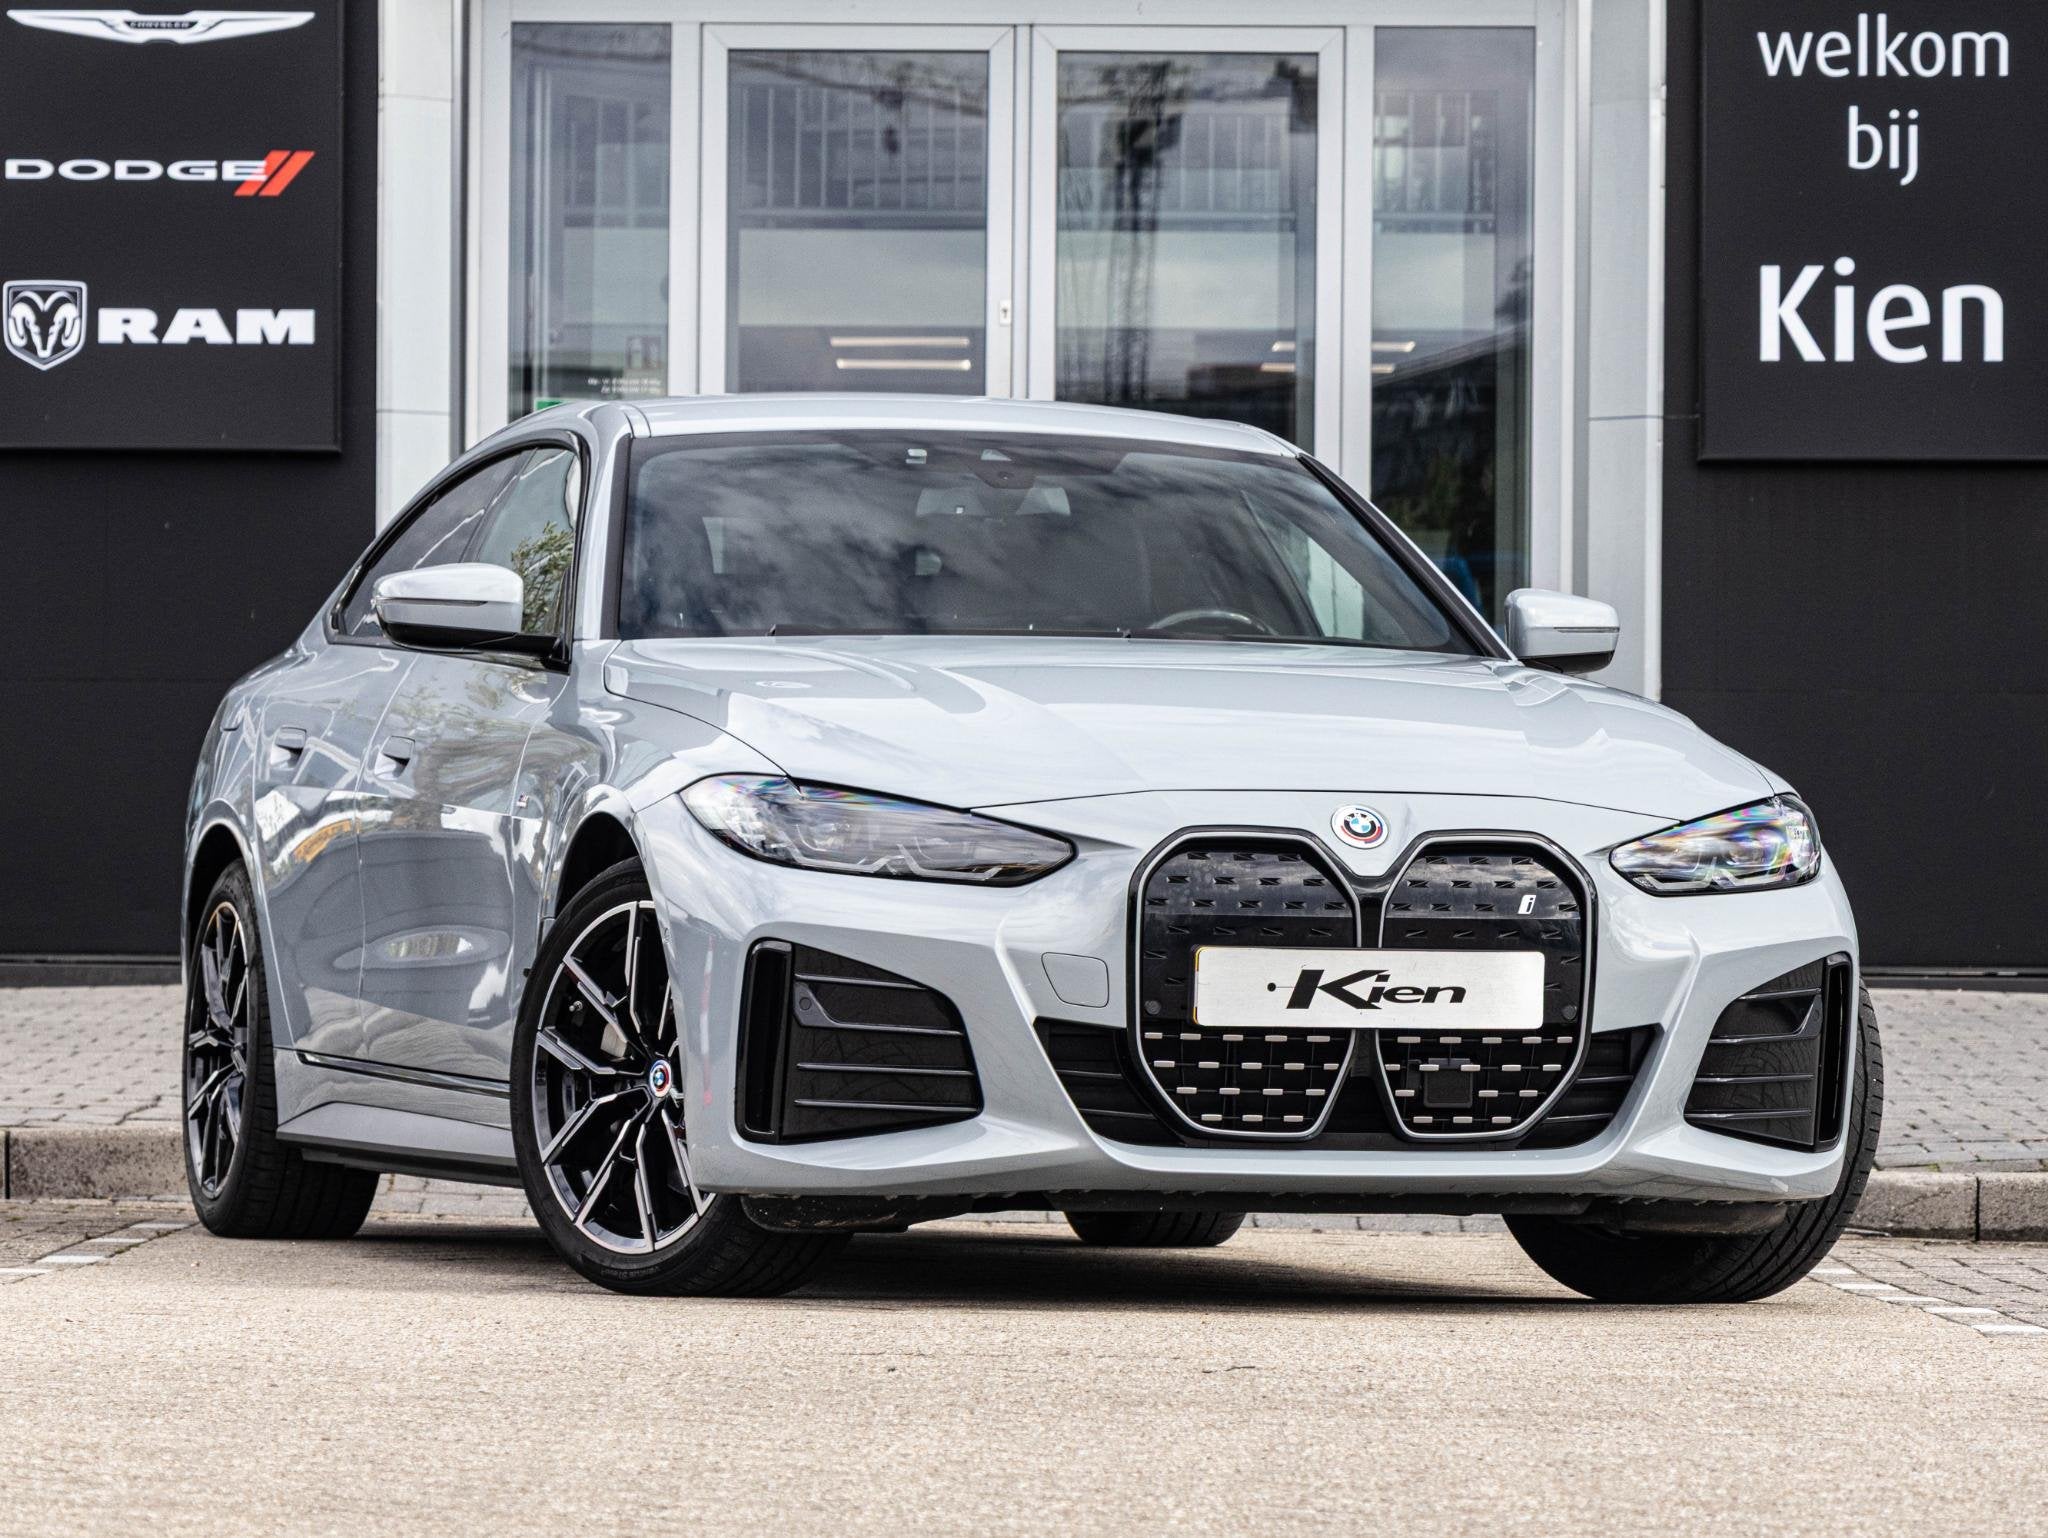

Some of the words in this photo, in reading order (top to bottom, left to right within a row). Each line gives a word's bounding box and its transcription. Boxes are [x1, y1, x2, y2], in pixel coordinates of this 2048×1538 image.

[1756, 12, 2009, 78] welkom
[5, 158, 267, 181] DODGE
[1848, 105, 1919, 186] bij
[97, 307, 316, 345] RAM
[1759, 256, 2004, 364] Kien
[1286, 969, 1467, 1010] Kien
